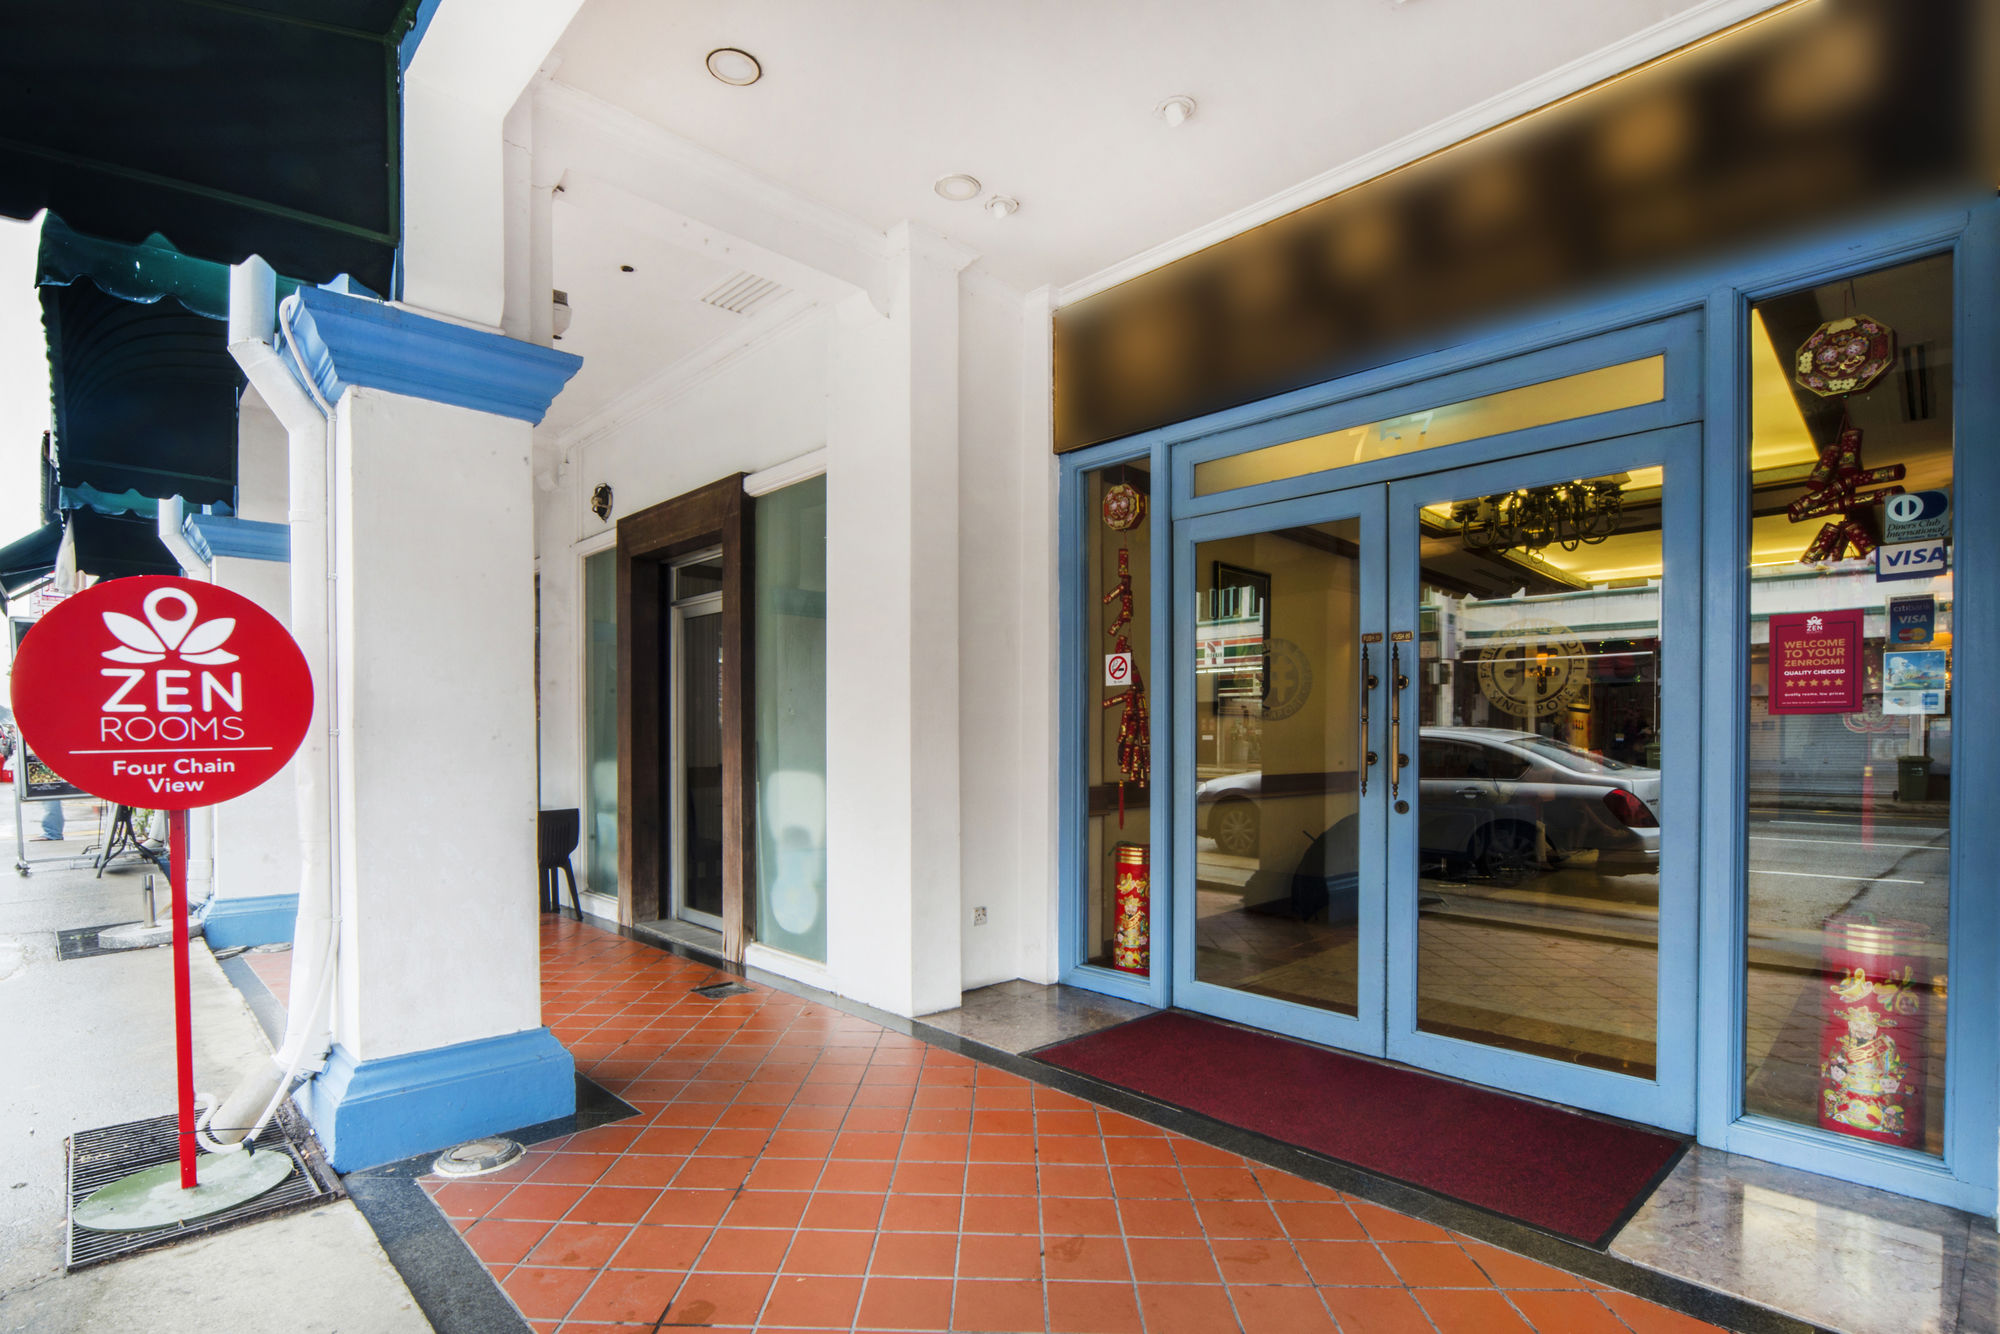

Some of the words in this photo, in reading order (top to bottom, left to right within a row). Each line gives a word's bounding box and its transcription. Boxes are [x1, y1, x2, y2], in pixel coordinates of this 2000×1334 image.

[1348, 411, 1434, 462] 757
[1886, 524, 1945, 538] International
[1888, 523, 1916, 532] Diners
[1919, 518, 1941, 527] Club
[1886, 546, 1944, 567] VISA
[1898, 614, 1928, 624] VISA
[1784, 638, 1846, 649] WELCOME
[1784, 650, 1803, 658] TO
[1807, 648, 1846, 657] YOUR
[1784, 658, 1845, 667] ZENROOM!
[100, 668, 243, 713] ZEN
[1490, 687, 1576, 714] SINGPORE
[101, 716, 245, 742] ROOMS
[113, 760, 167, 776] Four
[174, 758, 236, 774] Chain
[148, 778, 204, 793] View
